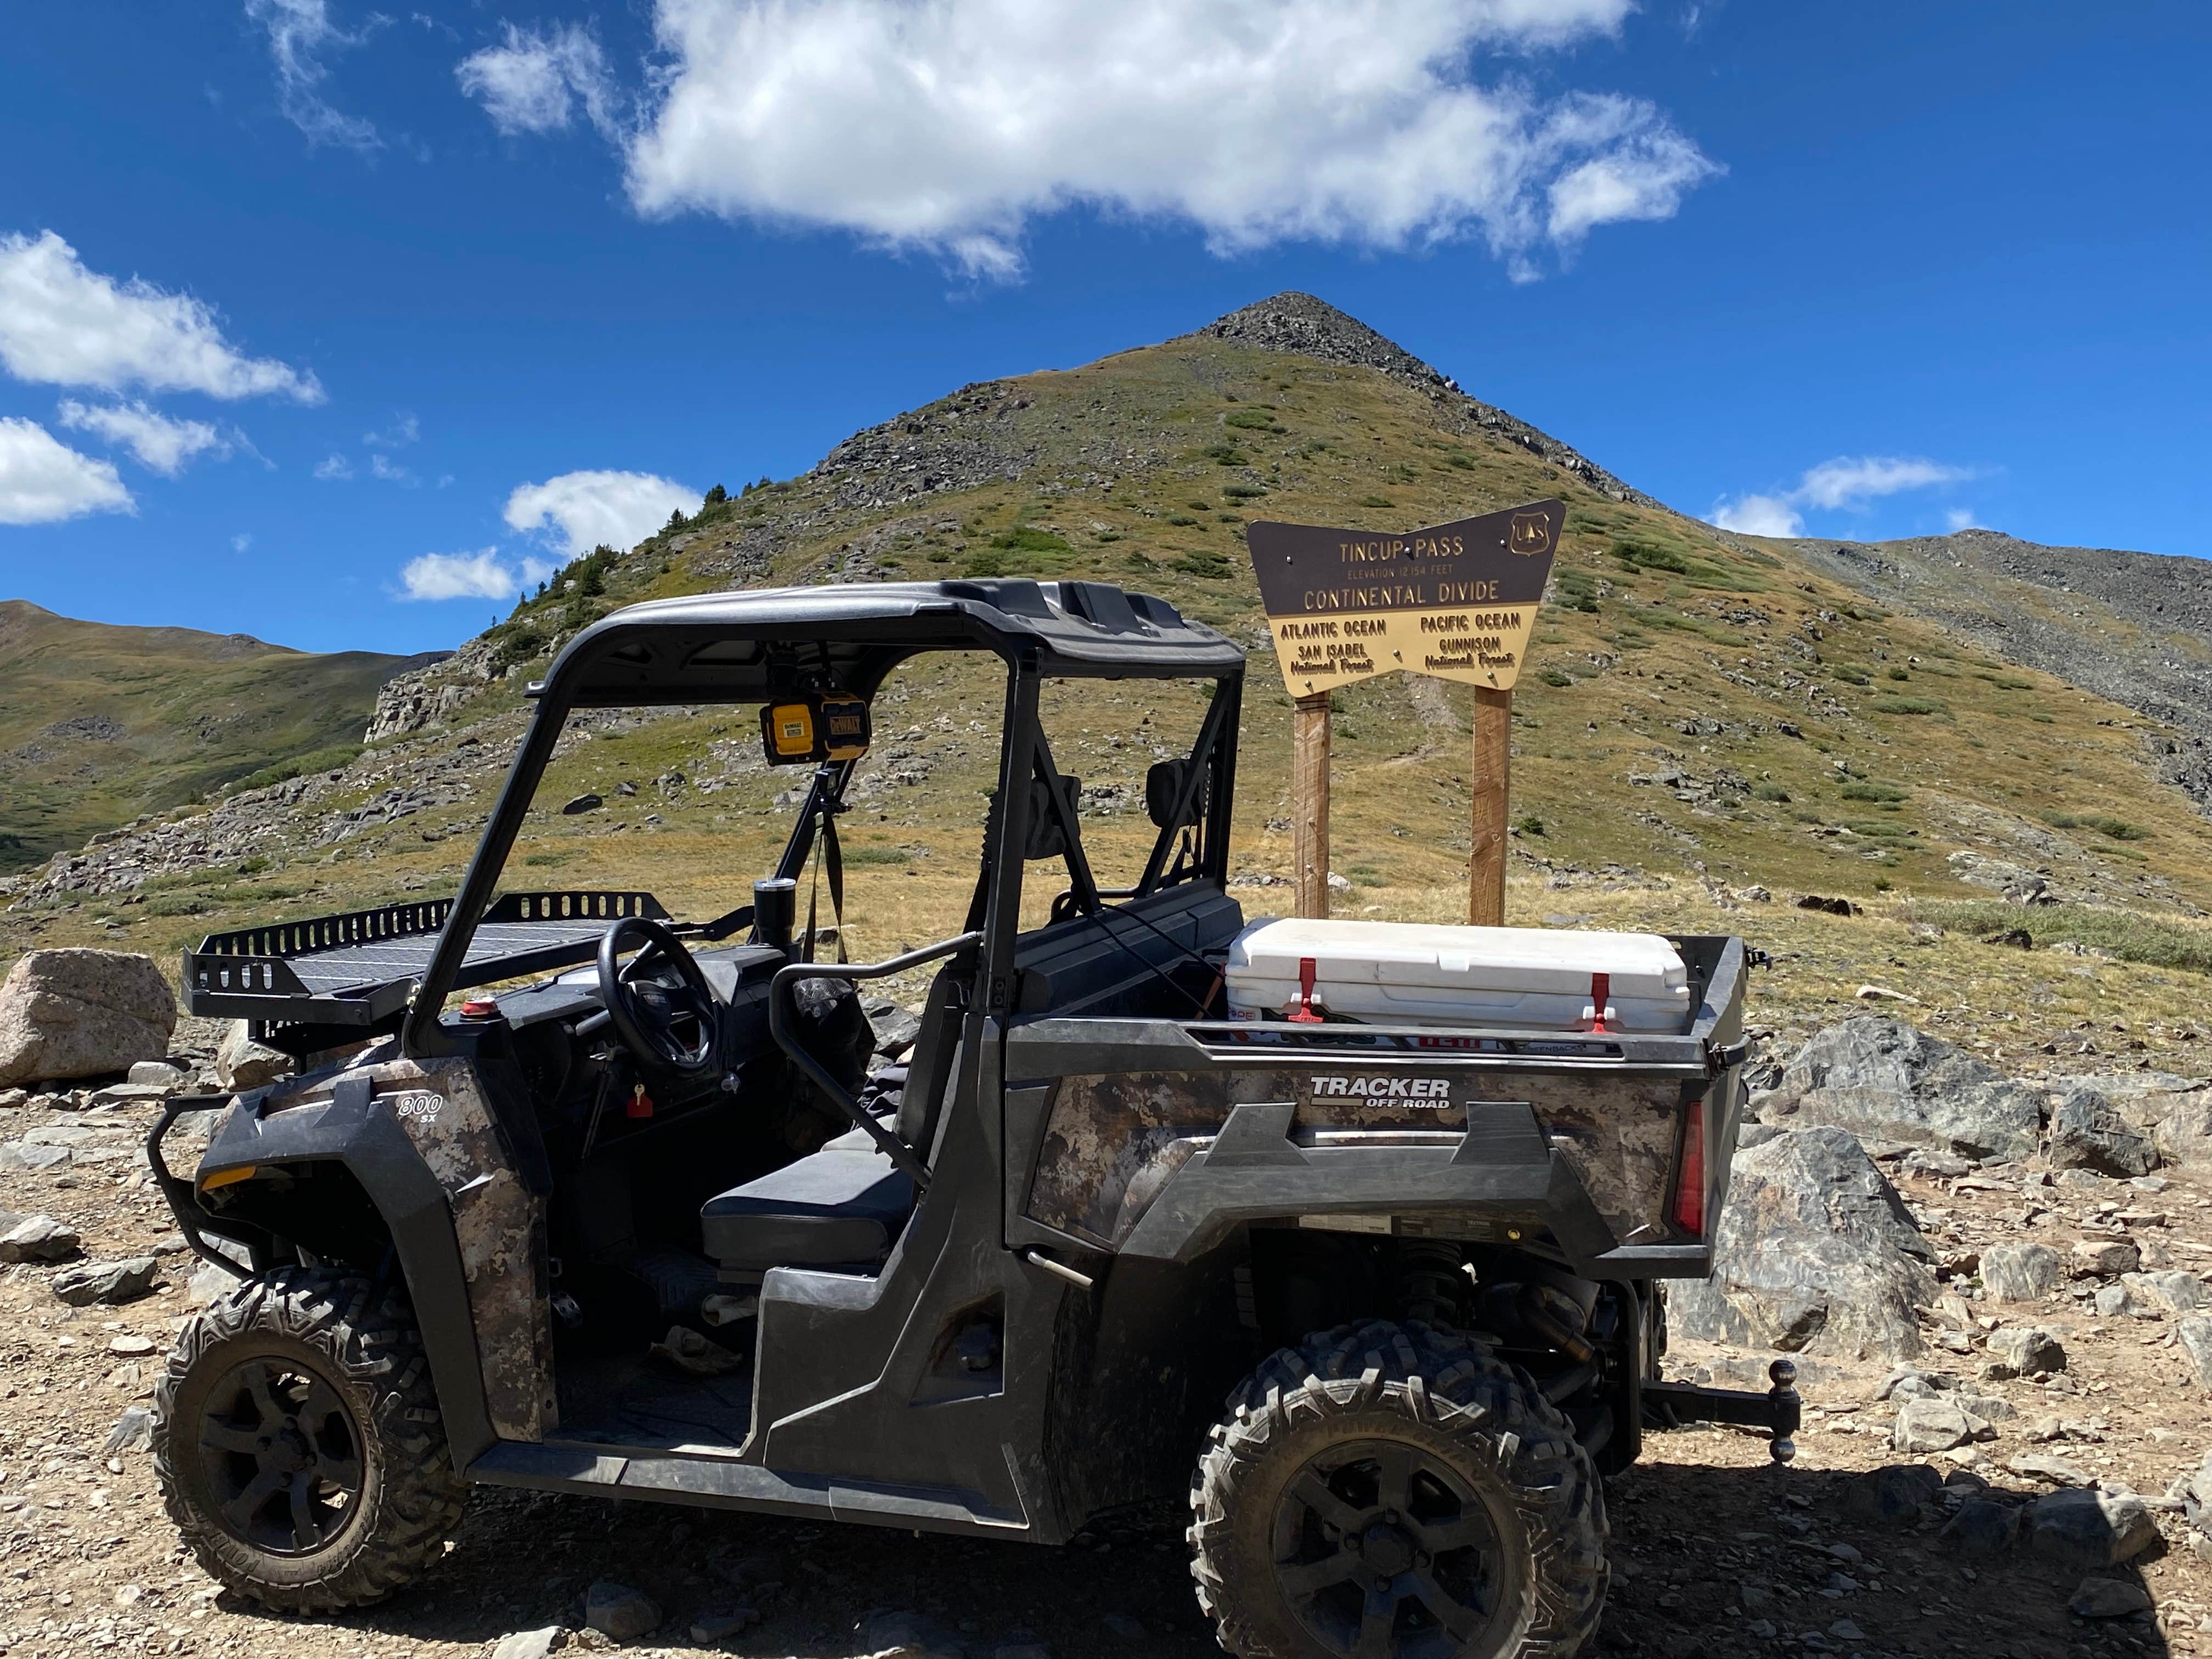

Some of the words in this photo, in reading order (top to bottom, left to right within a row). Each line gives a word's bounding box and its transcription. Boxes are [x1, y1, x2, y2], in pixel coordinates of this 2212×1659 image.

[1339, 540, 1403, 562] TINCUP
[1415, 535, 1464, 558] PASS
[1347, 568, 1395, 580] ELEVATION
[1431, 564, 1453, 575] FEET
[1304, 584, 1426, 610] CONTINENTAL
[1438, 579, 1499, 602] DIVIDE
[1280, 622, 1339, 640] ATLANTIC
[1344, 619, 1386, 637] OCEAN
[1421, 615, 1469, 633] PACIFIC
[1475, 612, 1521, 630] OCEAN
[1298, 645, 1322, 660] SAN
[1327, 643, 1368, 658] ISABEL
[1440, 636, 1501, 653] GUNNISON
[1291, 659, 1337, 675] National
[1340, 658, 1375, 674] Forest
[1425, 653, 1475, 670] National
[1478, 652, 1515, 669] Forest
[1311, 1077, 1450, 1097] TRACKER
[399, 1094, 443, 1116] 800
[1366, 1098, 1398, 1107] OFF
[1402, 1099, 1449, 1109] ROAD
